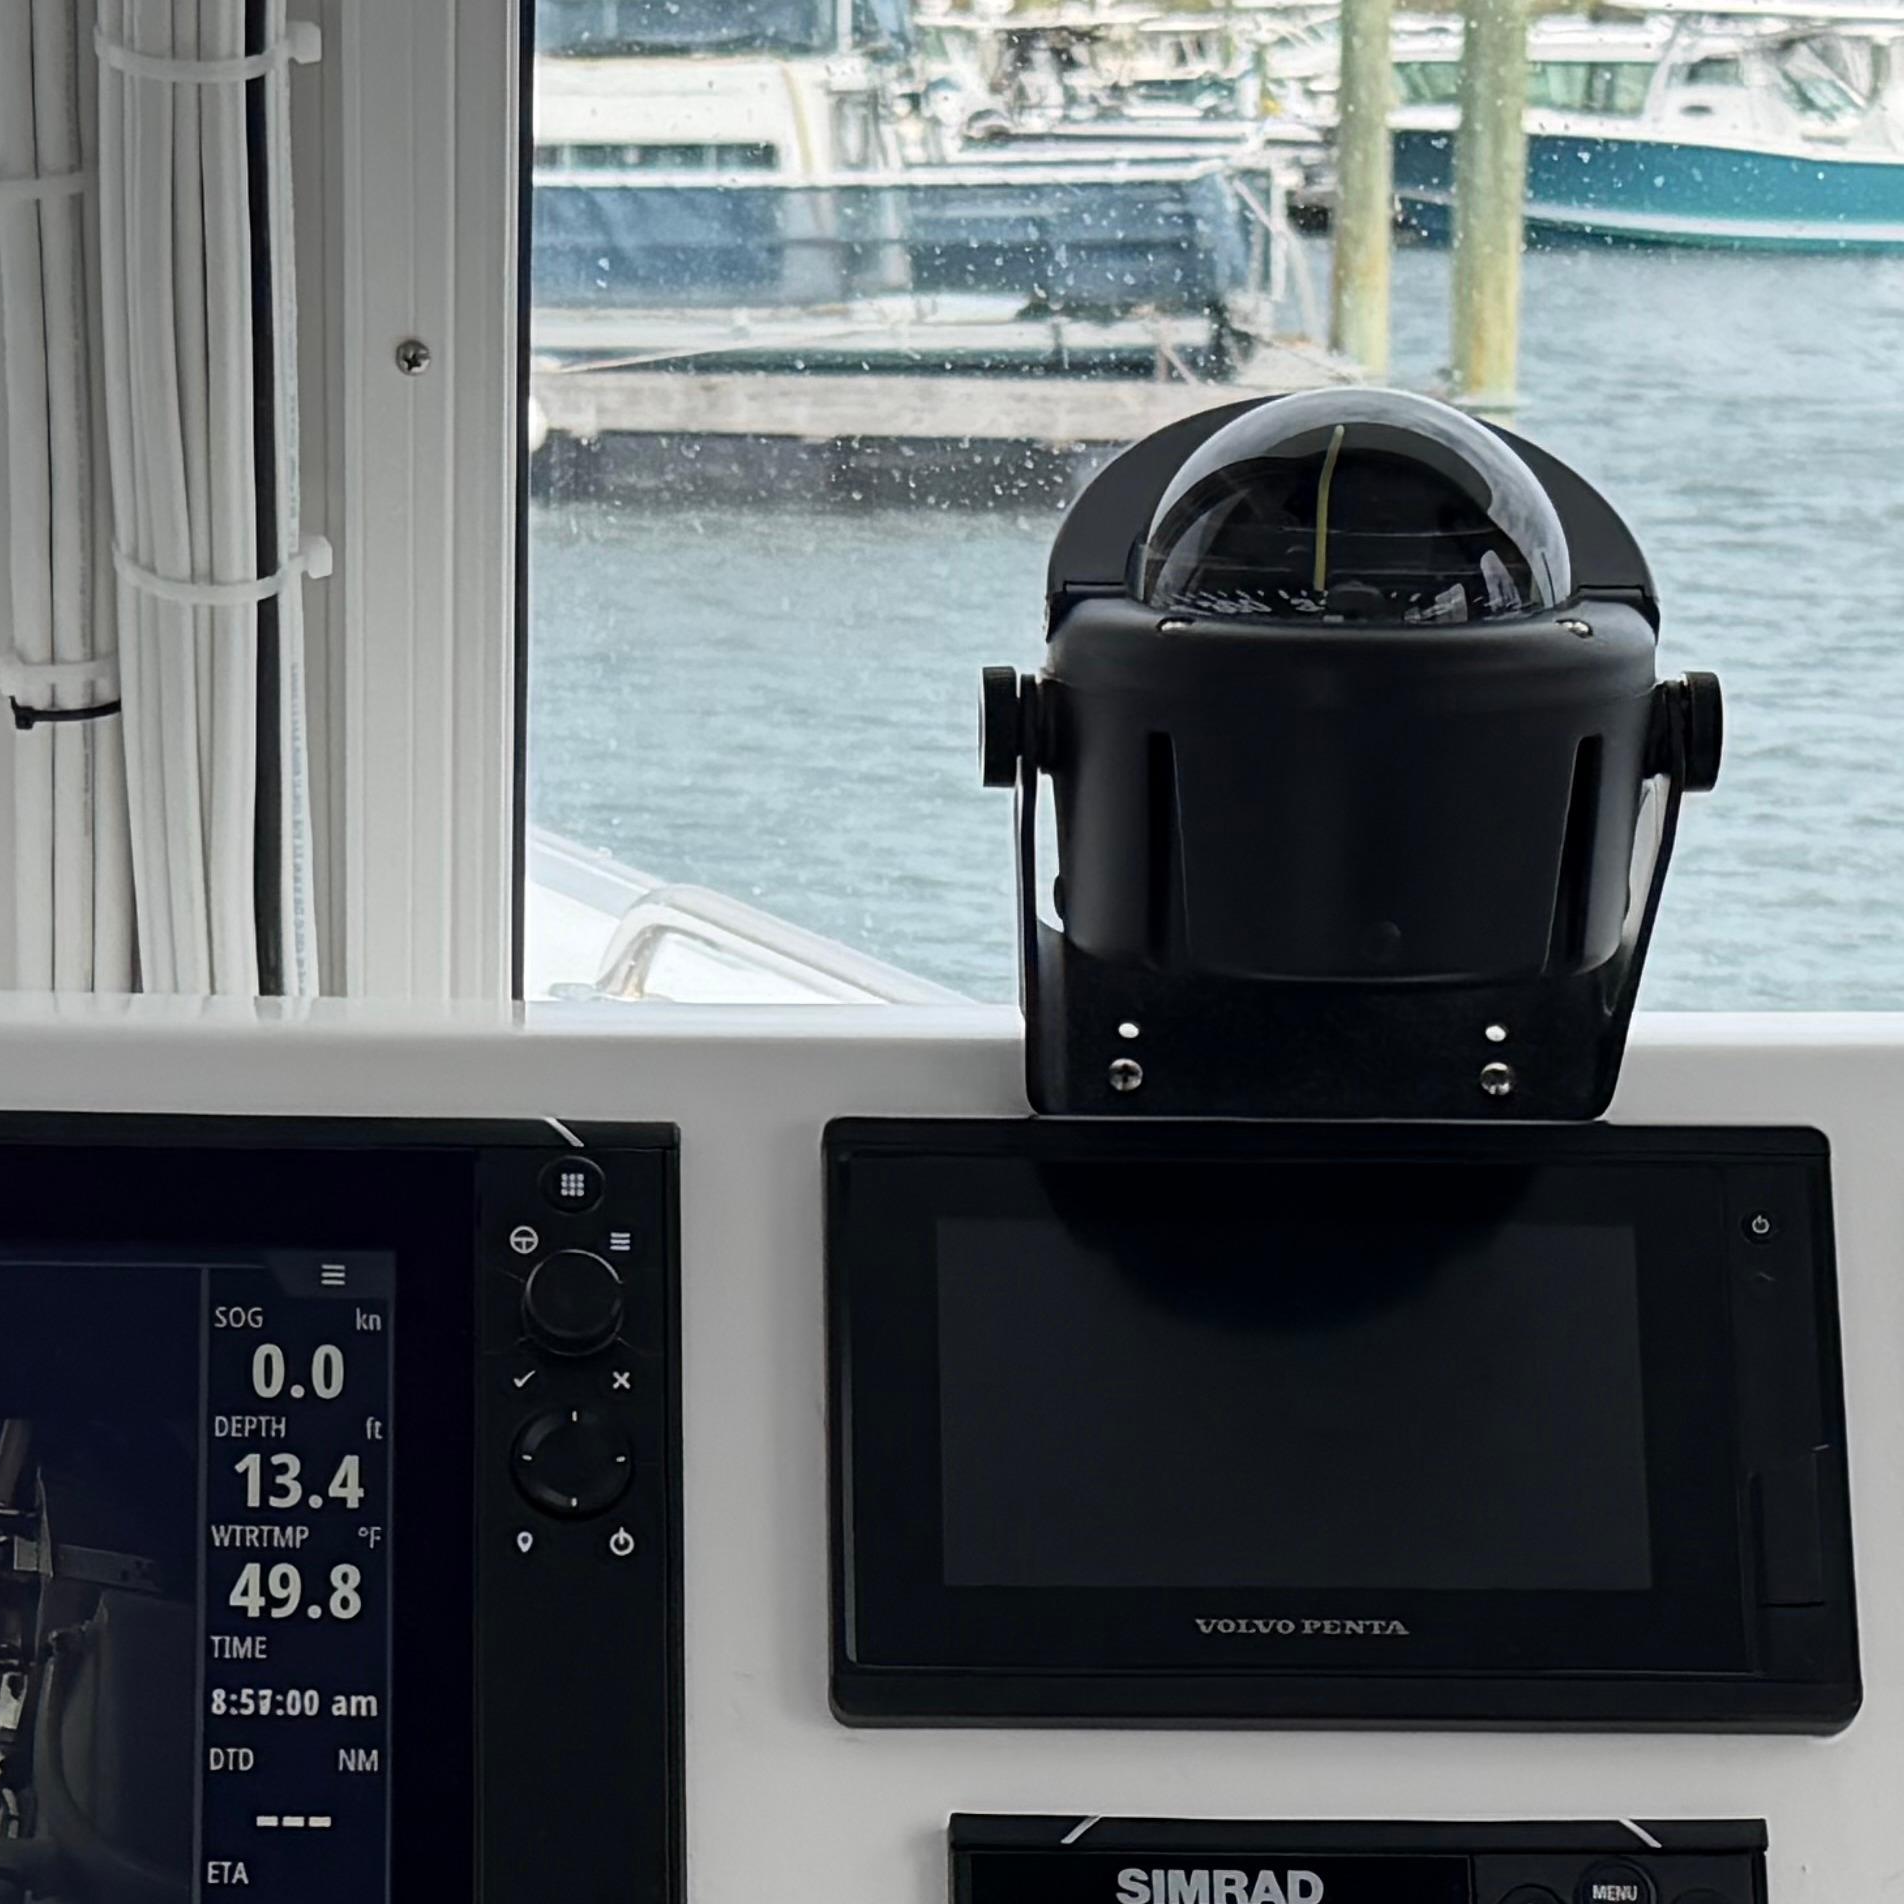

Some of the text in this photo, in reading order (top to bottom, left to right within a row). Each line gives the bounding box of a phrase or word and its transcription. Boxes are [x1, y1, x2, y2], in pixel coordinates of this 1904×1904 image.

[215, 1307, 381, 1331] SOG kn
[252, 1343, 344, 1400] 0.0
[215, 1416, 383, 1440] DEPTH ft
[234, 1452, 365, 1509] 13.4
[211, 1525, 381, 1550] WTRTMP °F
[229, 1562, 362, 1619] 49.8
[1194, 1617, 1409, 1637] VOLVO PENTA
[210, 1636, 268, 1659] TIME
[331, 1694, 379, 1718] am
[208, 1748, 380, 1772] DTD NM
[207, 1861, 250, 1885] ETA
[1592, 1883, 1638, 1902] MENU
